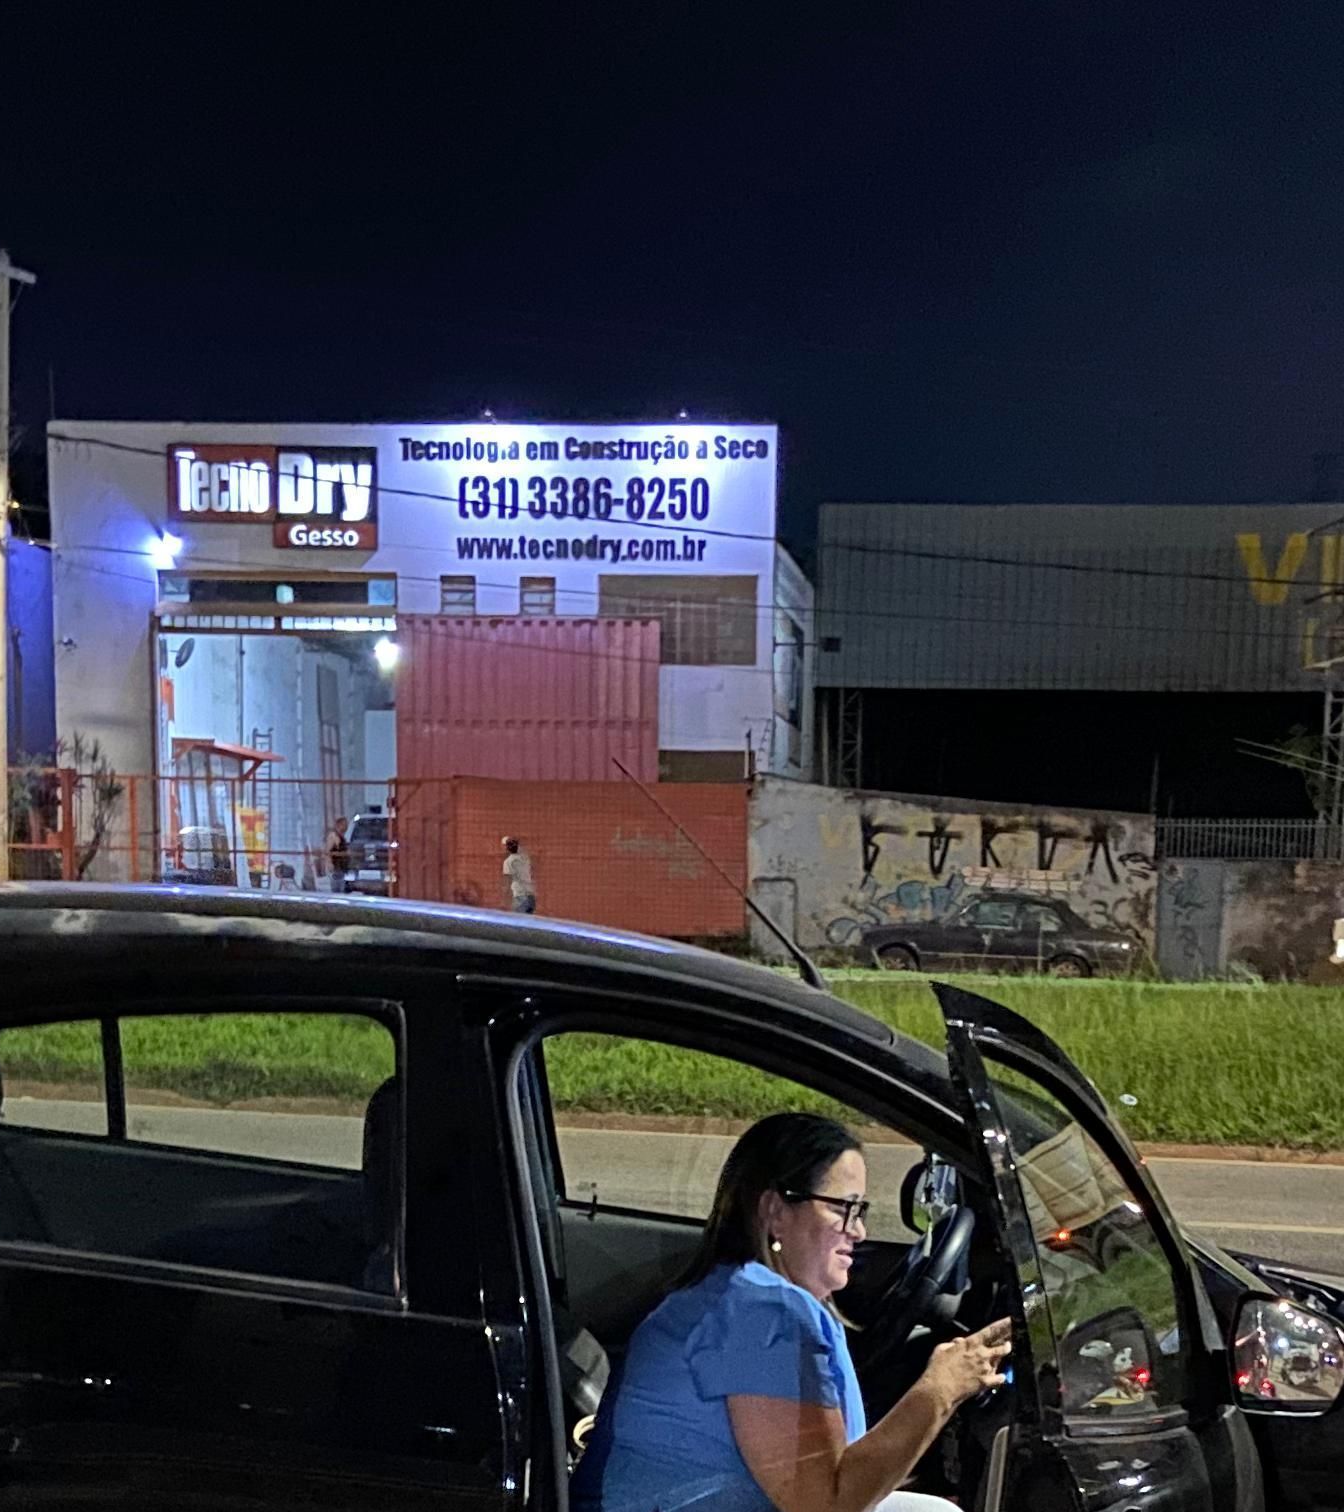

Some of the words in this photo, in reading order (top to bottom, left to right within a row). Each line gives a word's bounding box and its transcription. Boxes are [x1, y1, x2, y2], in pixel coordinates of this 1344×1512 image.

[526, 439, 559, 461] em
[564, 436, 689, 465] Construção
[714, 436, 769, 460] Seco
[278, 452, 372, 521] Dry
[458, 476, 520, 520] (31)
[527, 476, 709, 521] 3386-8250
[289, 524, 359, 547] Gesso
[456, 534, 707, 564] www.tecnodry.com.br
